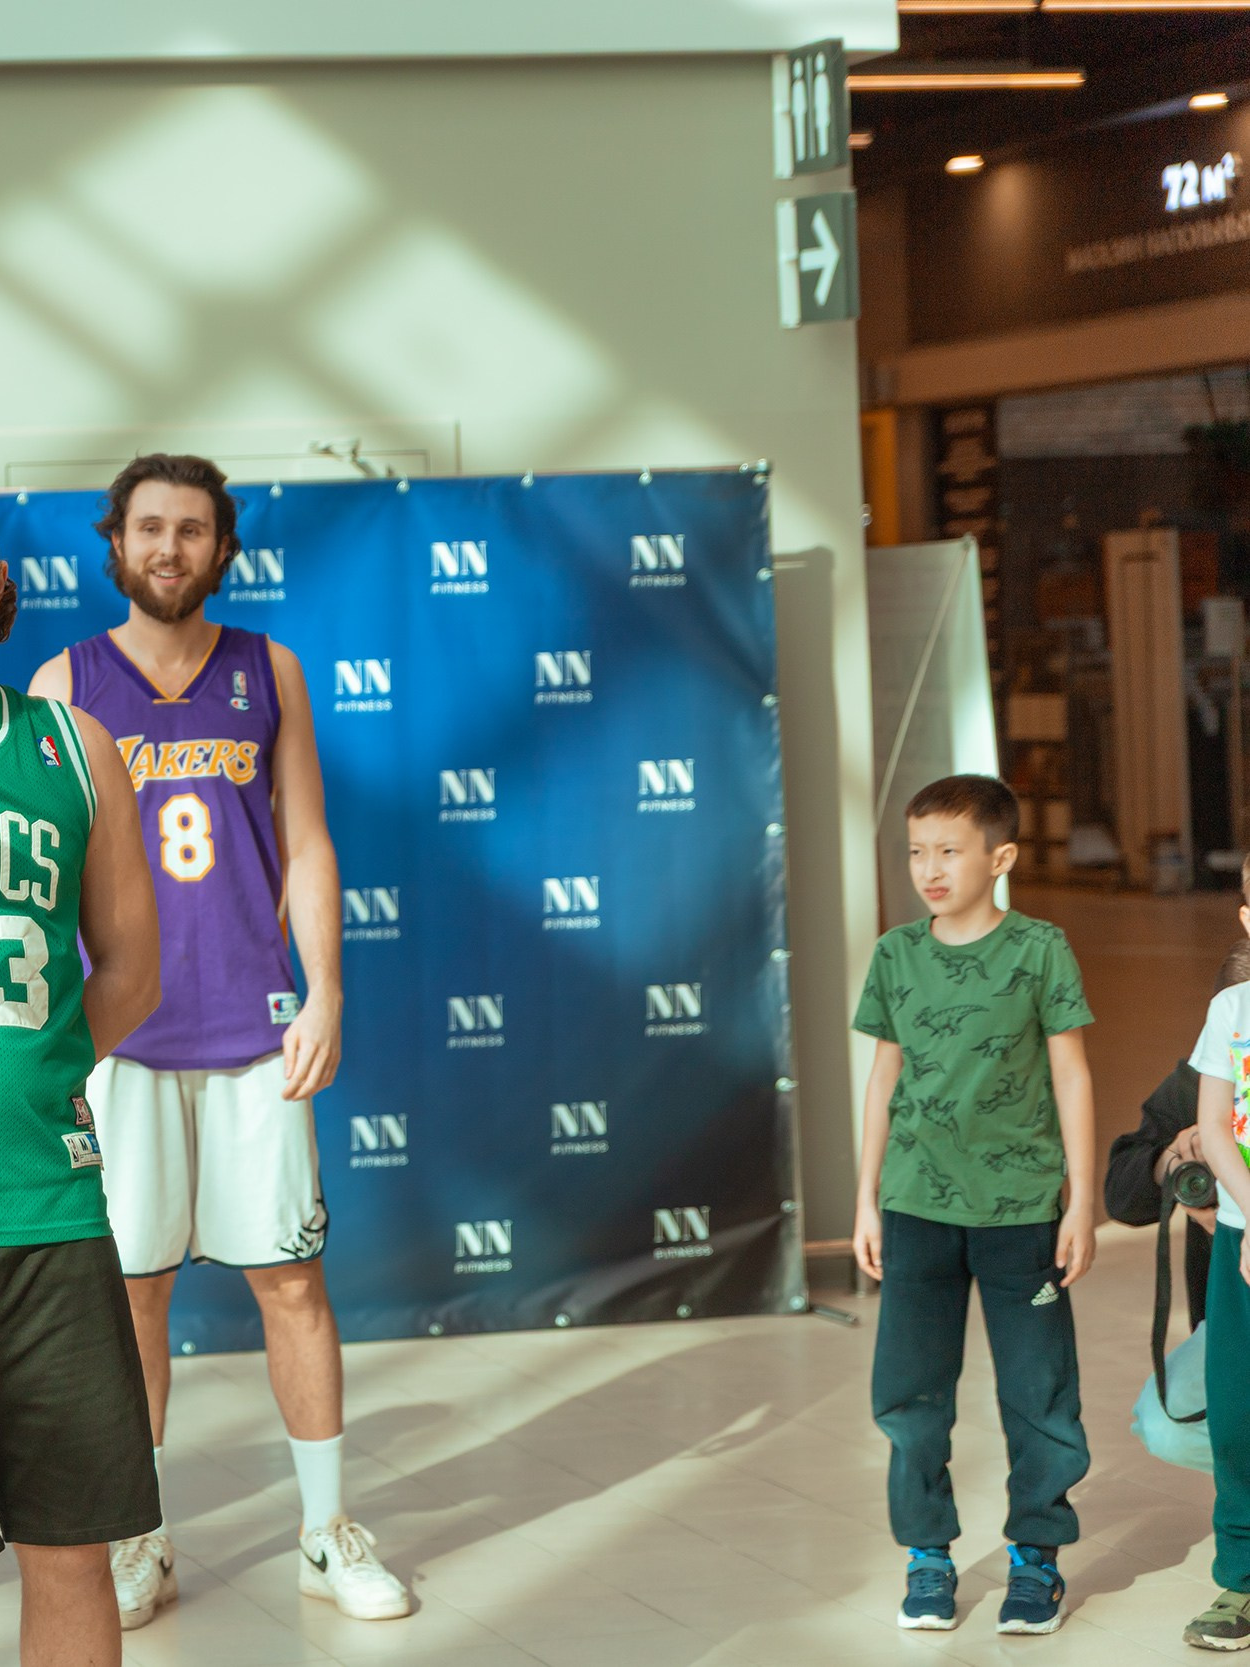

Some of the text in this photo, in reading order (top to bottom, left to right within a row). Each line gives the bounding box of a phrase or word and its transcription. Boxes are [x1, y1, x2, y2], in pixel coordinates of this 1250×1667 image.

[1162, 161, 1199, 210] 72
[229, 548, 285, 584] NN
[429, 540, 488, 577] NN
[631, 534, 686, 570] NN
[21, 555, 78, 591] NN
[430, 581, 489, 594] FITNESS
[630, 575, 687, 587] FITNESS
[22, 596, 80, 608] FITNESS
[230, 589, 286, 601] FITNESS
[334, 658, 391, 695] NN
[535, 650, 591, 687] NN
[334, 700, 392, 712] FITNESS
[535, 691, 593, 703] FITNESS
[116, 734, 259, 792] LAKERS
[638, 758, 695, 794] NN
[439, 768, 496, 803] NN
[440, 809, 497, 821] FITNESS
[638, 799, 695, 811] FITNESS
[158, 793, 215, 882] 8
[344, 887, 400, 922] NN
[543, 876, 599, 912] NN
[345, 927, 401, 940] FITNESS
[543, 917, 601, 929] FITNESS
[448, 994, 503, 1030] NN
[646, 983, 702, 1018] NN
[448, 1035, 505, 1047] FITNESS
[646, 1023, 703, 1035] FITNESS
[350, 1113, 407, 1150] NN
[551, 1101, 608, 1138] NN
[350, 1155, 408, 1167] FITNESS
[551, 1142, 609, 1154] FITNESS
[455, 1220, 513, 1256] NN
[654, 1206, 710, 1242] NN
[455, 1260, 513, 1272] FITNESS
[654, 1246, 712, 1259] FITNESS
